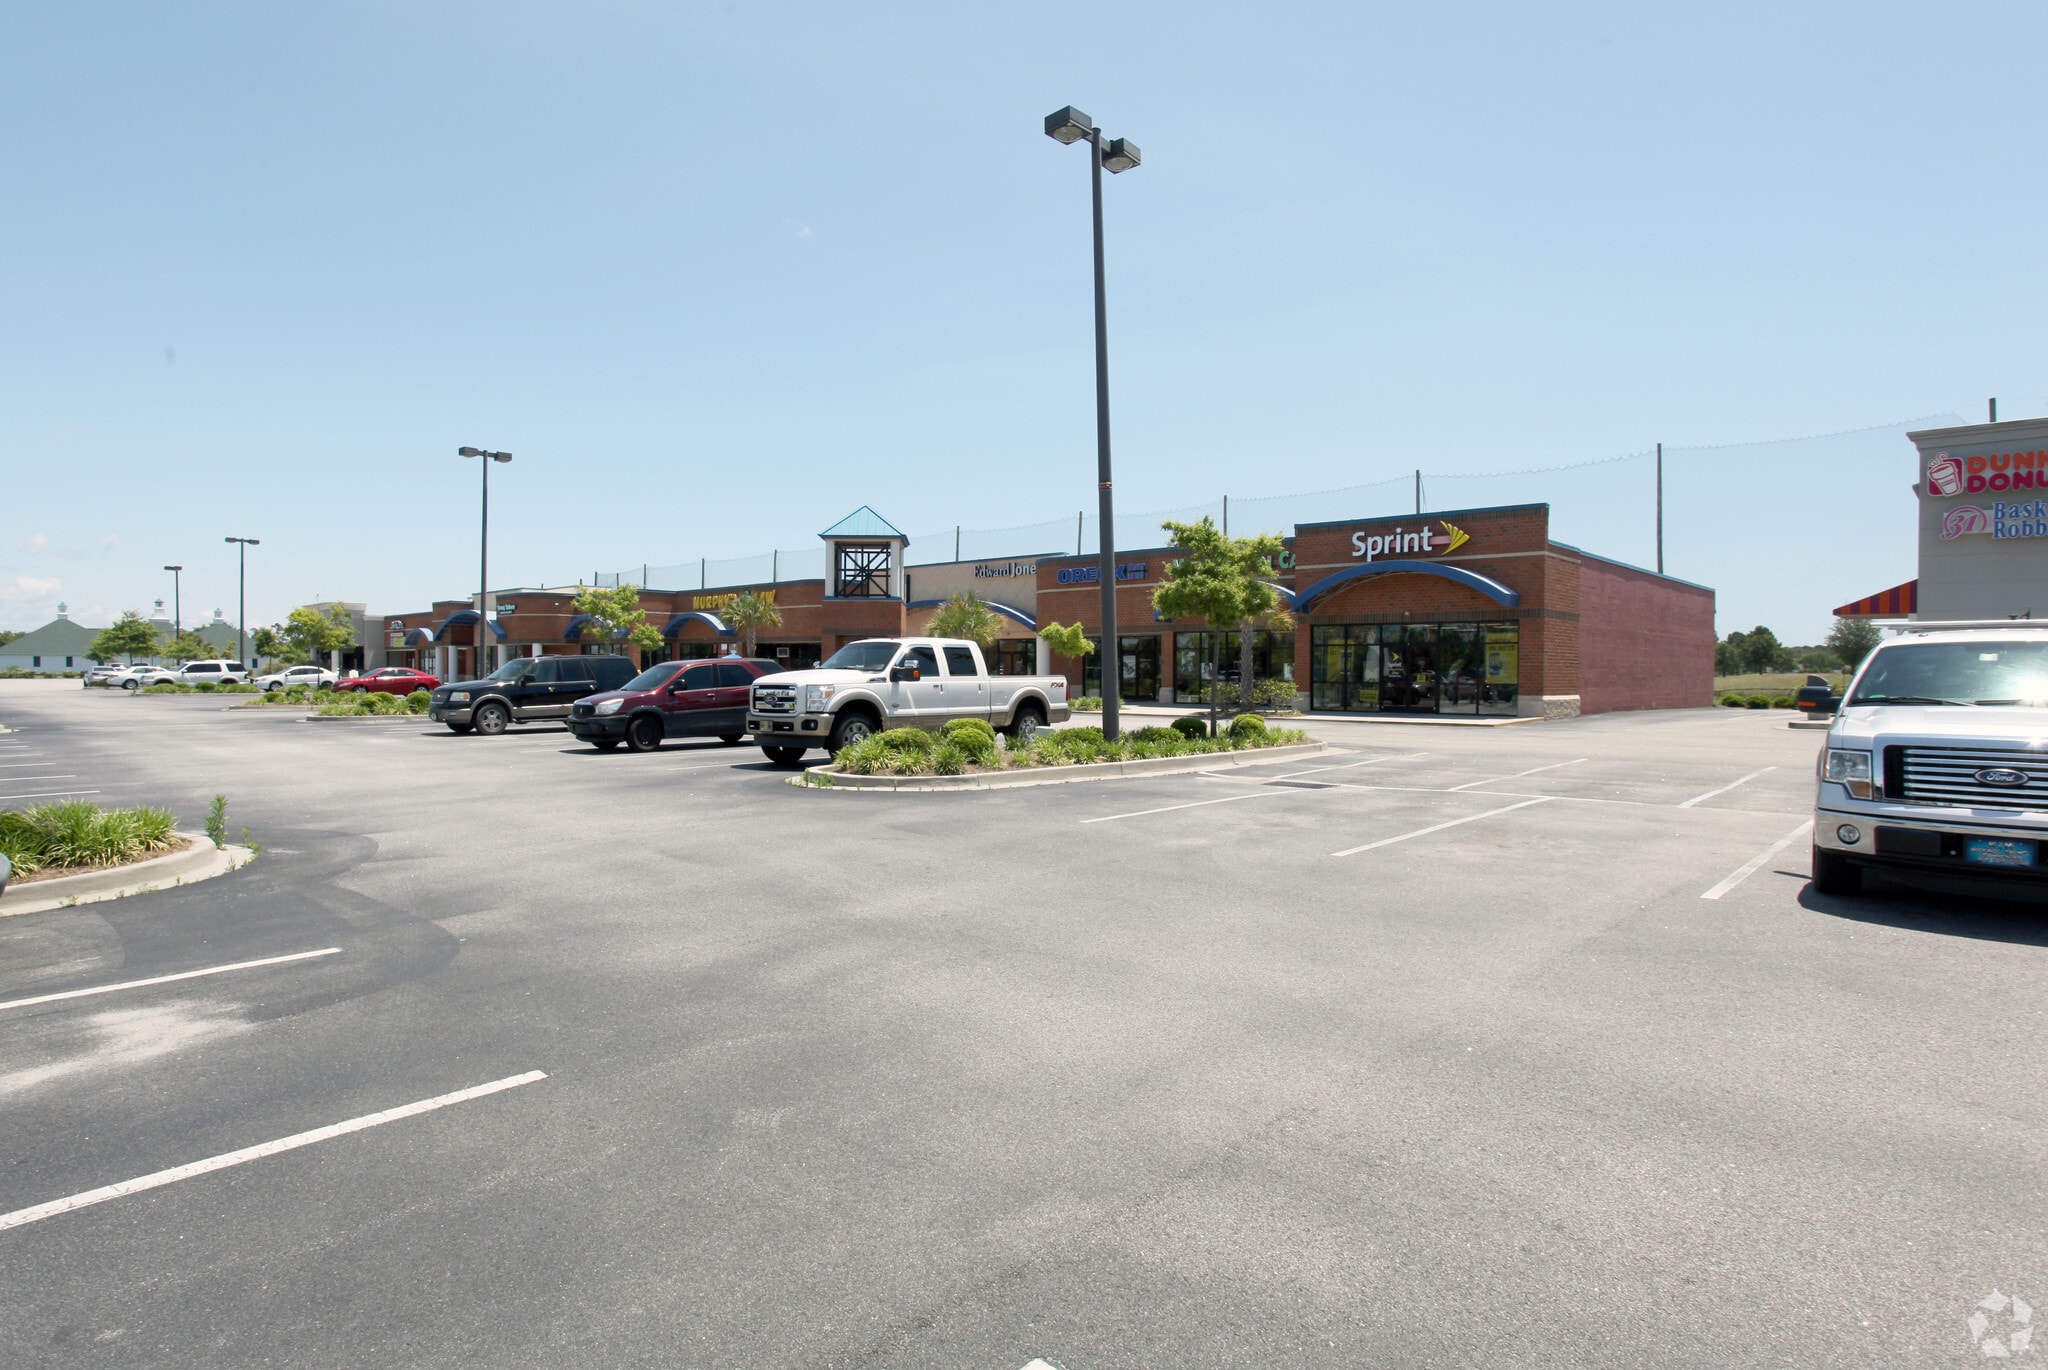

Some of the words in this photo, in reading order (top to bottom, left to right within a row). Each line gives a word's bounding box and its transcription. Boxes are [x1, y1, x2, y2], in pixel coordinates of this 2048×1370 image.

[1993, 500, 2048, 520] Bask
[1993, 519, 2048, 539] Robb
[1351, 525, 1433, 562] Sprint
[973, 563, 1010, 578] Edward
[1057, 565, 1128, 584] OREK
[1986, 771, 2016, 782] Ford
